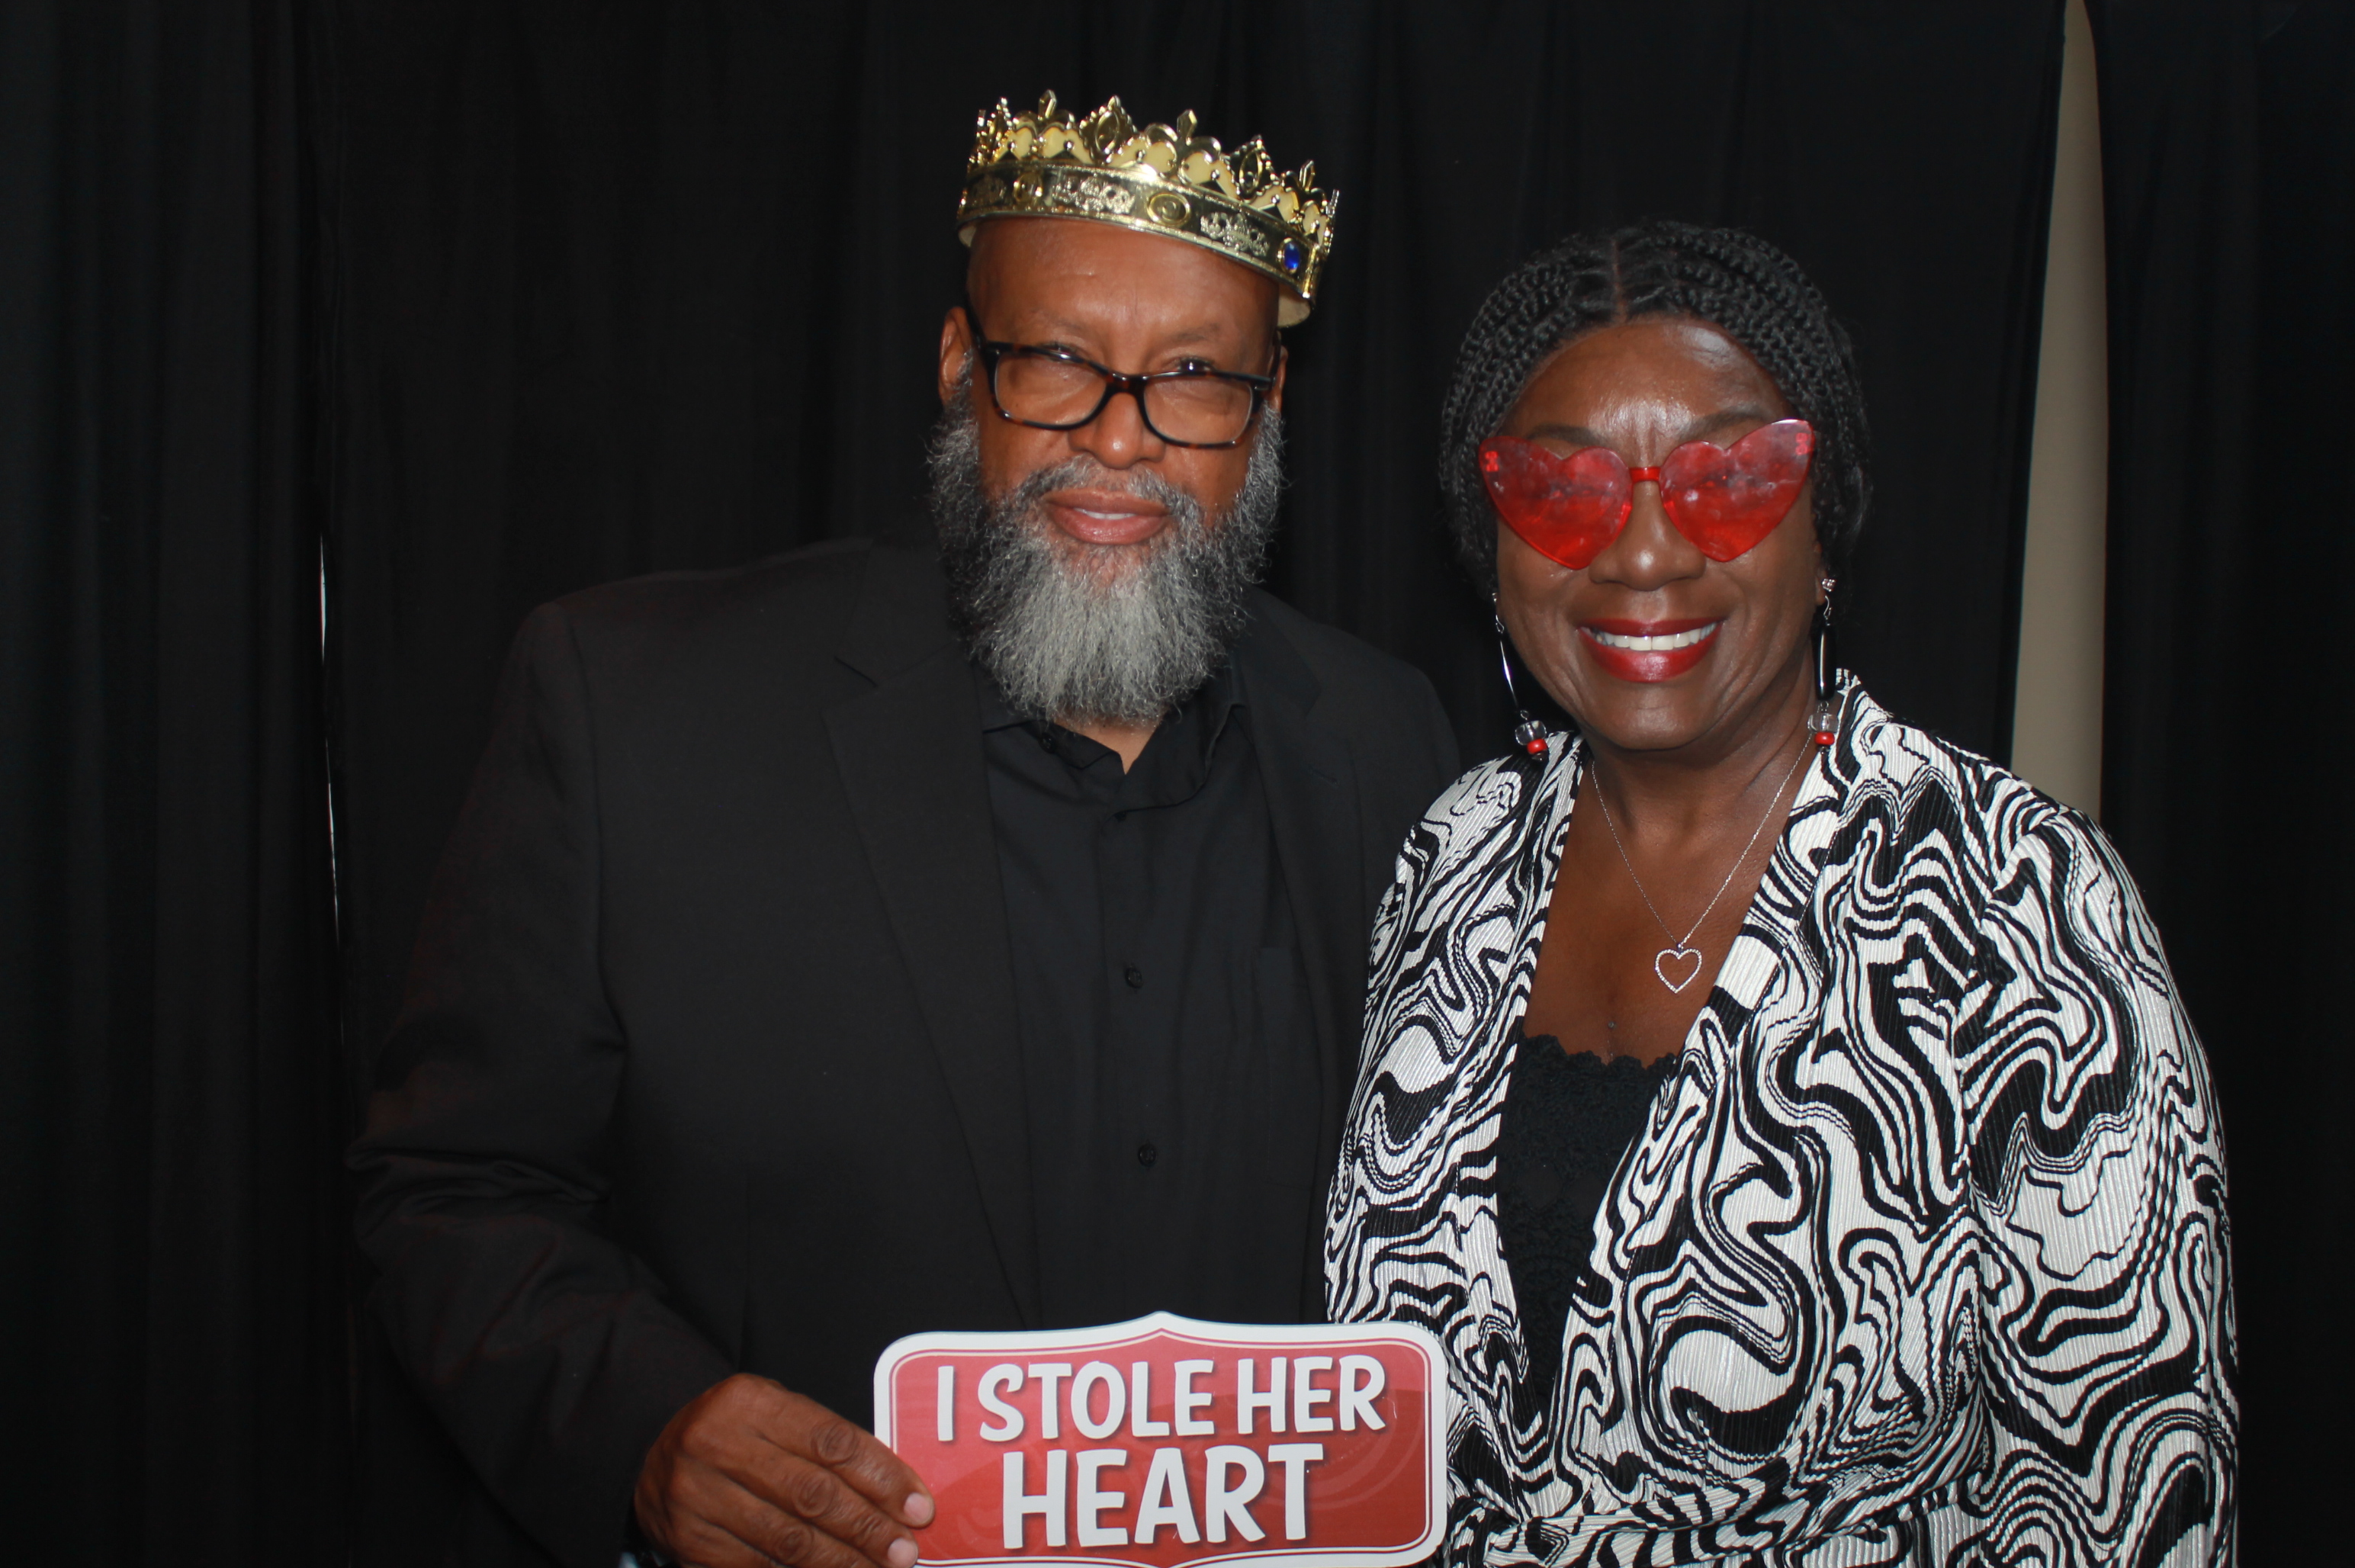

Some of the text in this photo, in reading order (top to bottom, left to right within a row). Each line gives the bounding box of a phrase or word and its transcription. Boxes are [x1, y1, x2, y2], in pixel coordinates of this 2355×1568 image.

[937, 1354, 1386, 1442] I STOLE HER
[1002, 1443, 1325, 1550] HEART
